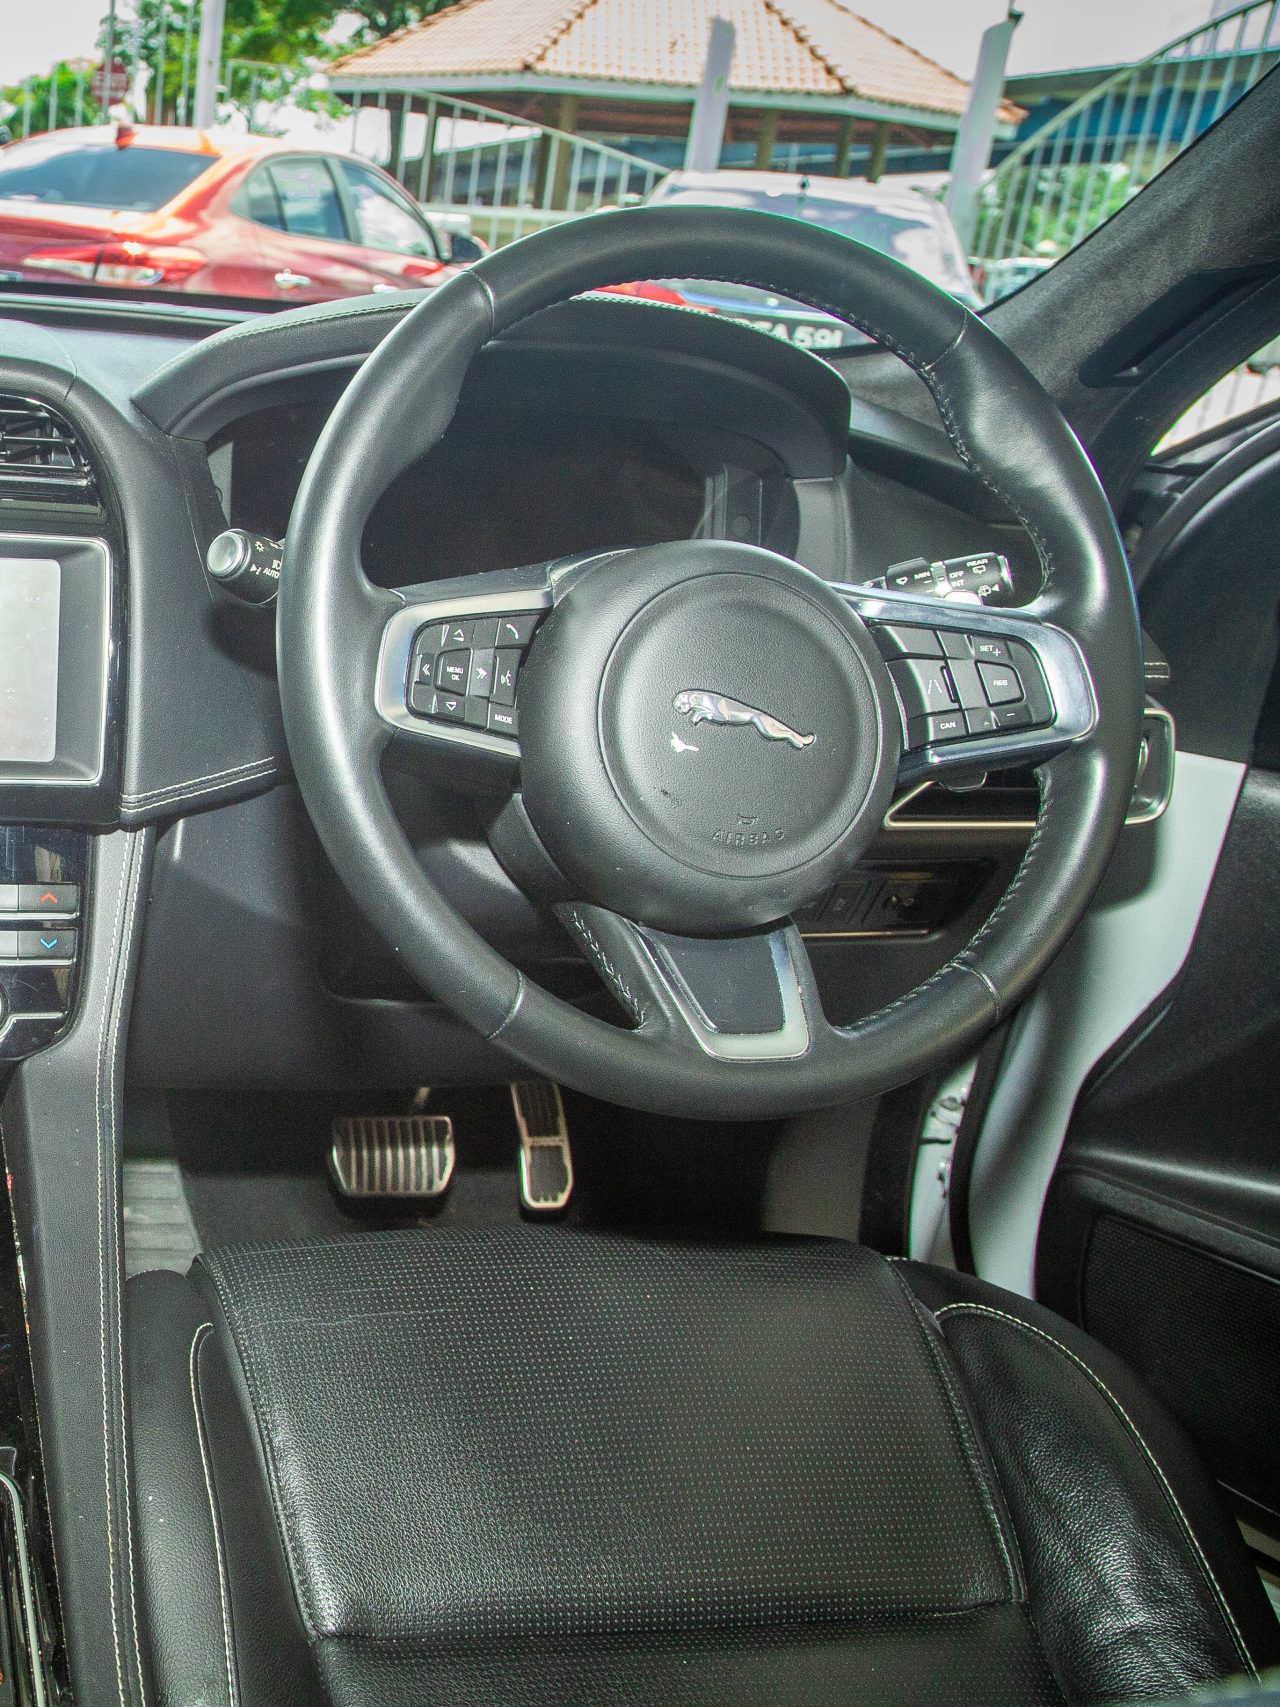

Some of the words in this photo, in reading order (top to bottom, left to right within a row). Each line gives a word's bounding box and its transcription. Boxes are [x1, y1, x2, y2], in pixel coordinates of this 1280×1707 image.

[966, 558, 989, 567] REAR
[263, 567, 280, 579] AUTO
[914, 571, 931, 580] MIN
[949, 571, 965, 579] OFF
[446, 665, 464, 674] MENU
[993, 679, 1008, 687] RES
[494, 713, 513, 725] MODE
[940, 721, 956, 730] CAN
